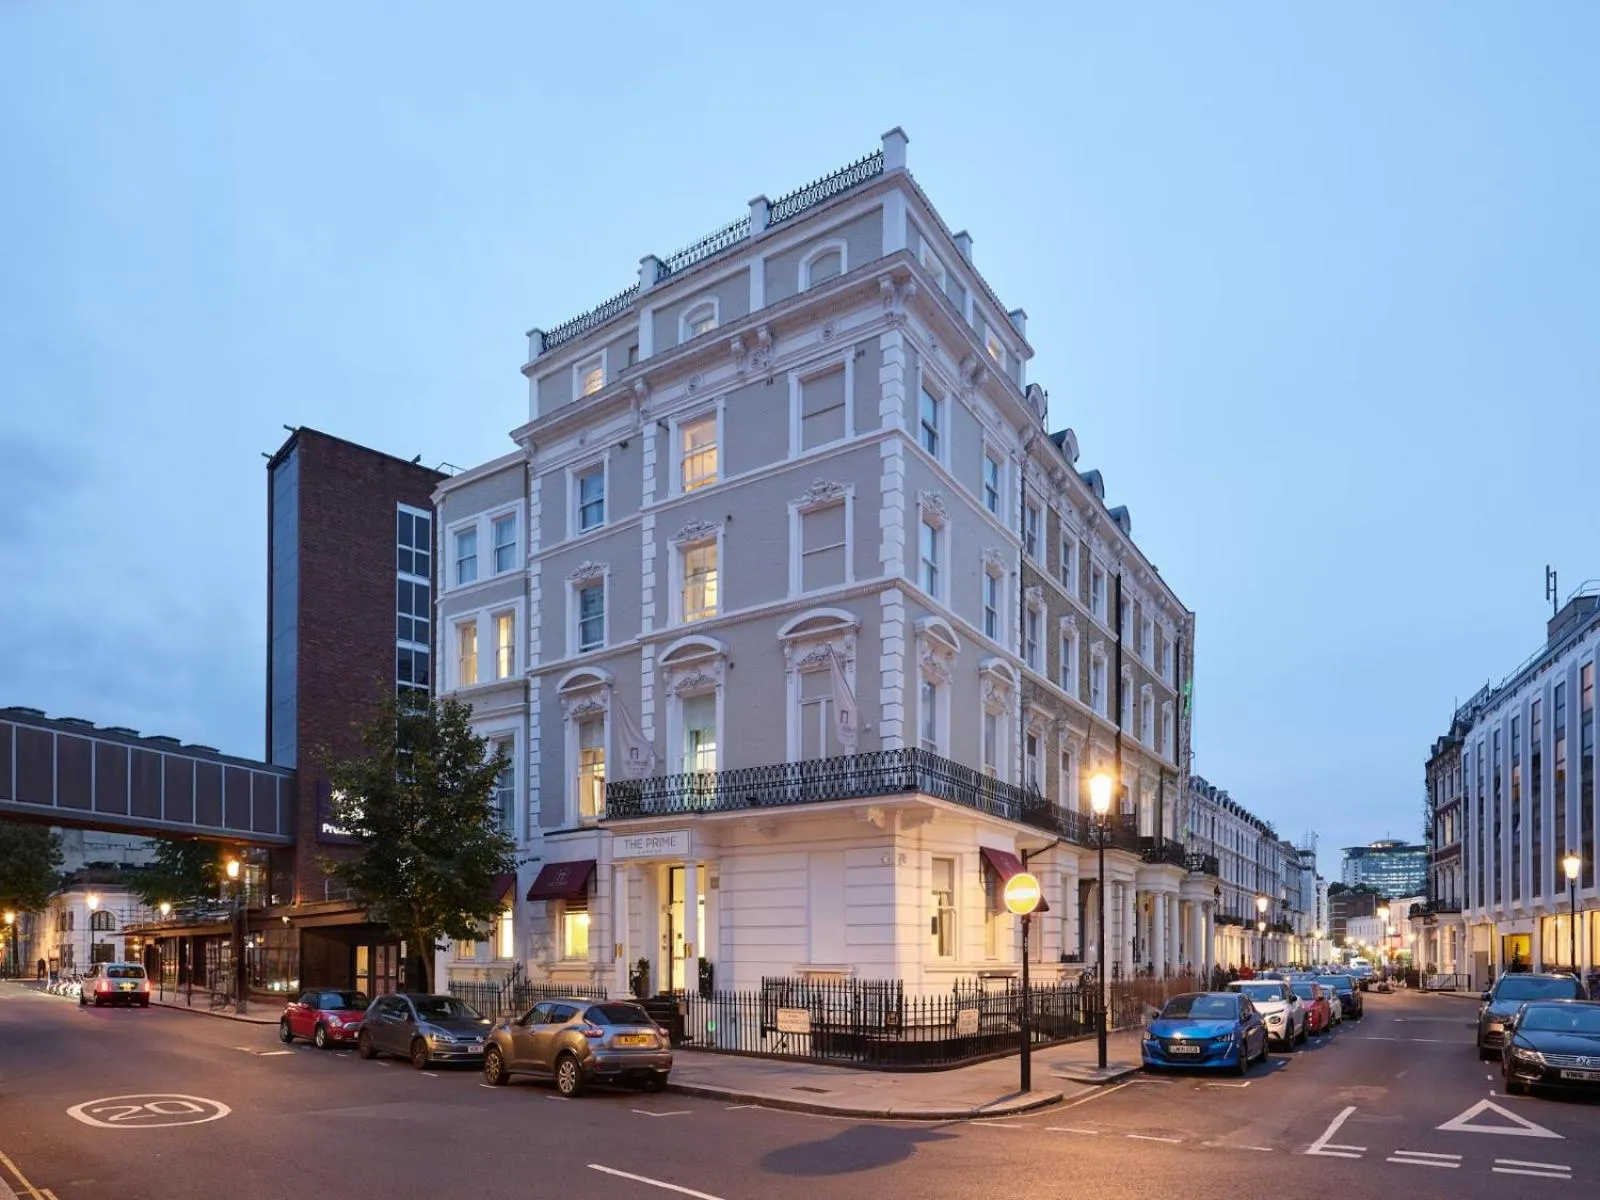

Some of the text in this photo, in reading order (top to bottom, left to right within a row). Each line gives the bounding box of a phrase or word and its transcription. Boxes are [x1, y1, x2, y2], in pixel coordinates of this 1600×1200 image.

[623, 836, 676, 849] THE PRIME
[92, 1101, 204, 1121] 20
